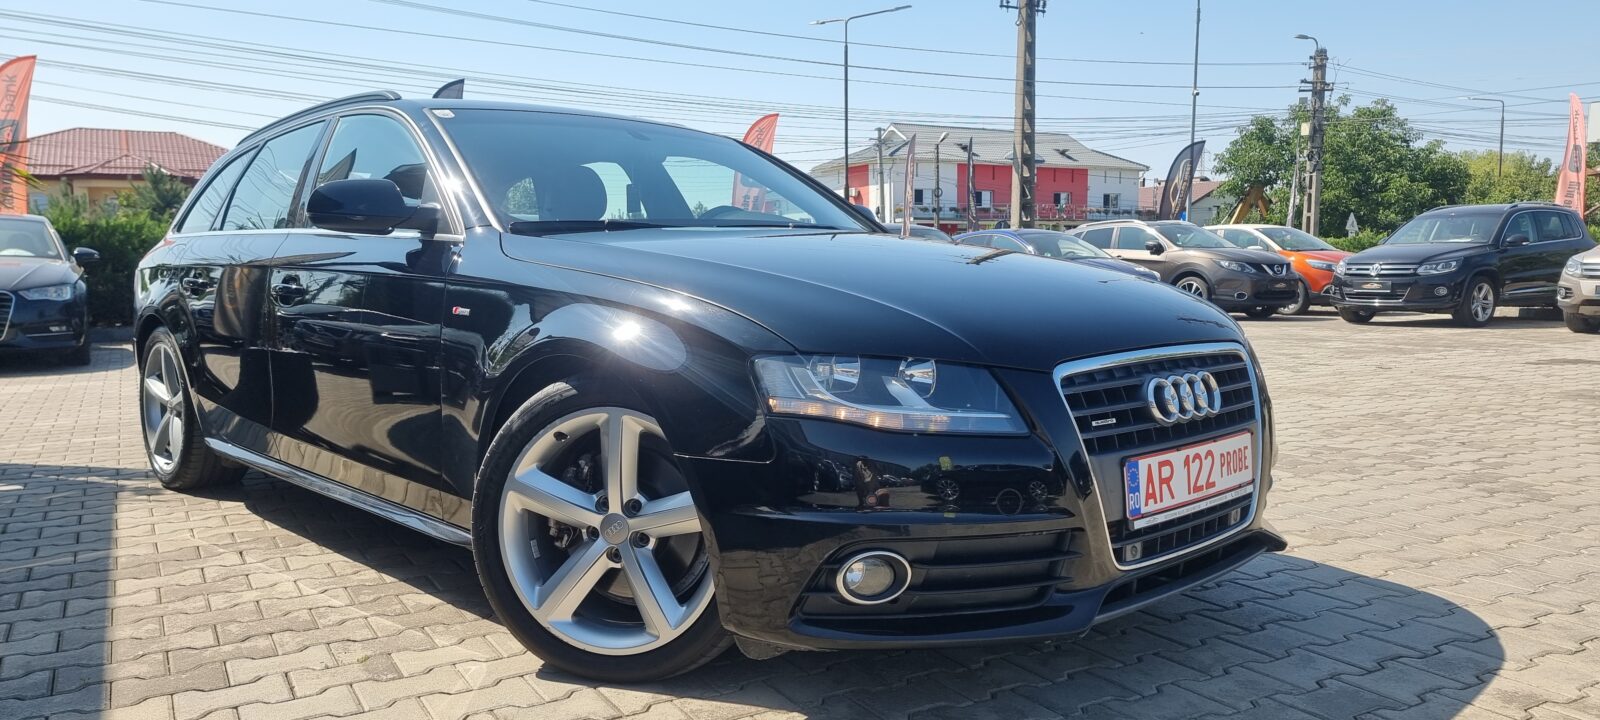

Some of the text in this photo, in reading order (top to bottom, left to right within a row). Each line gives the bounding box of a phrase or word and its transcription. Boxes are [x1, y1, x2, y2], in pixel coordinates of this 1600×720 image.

[1145, 446, 1249, 507] AR 122 PROBE
[1129, 492, 1140, 511] RO
